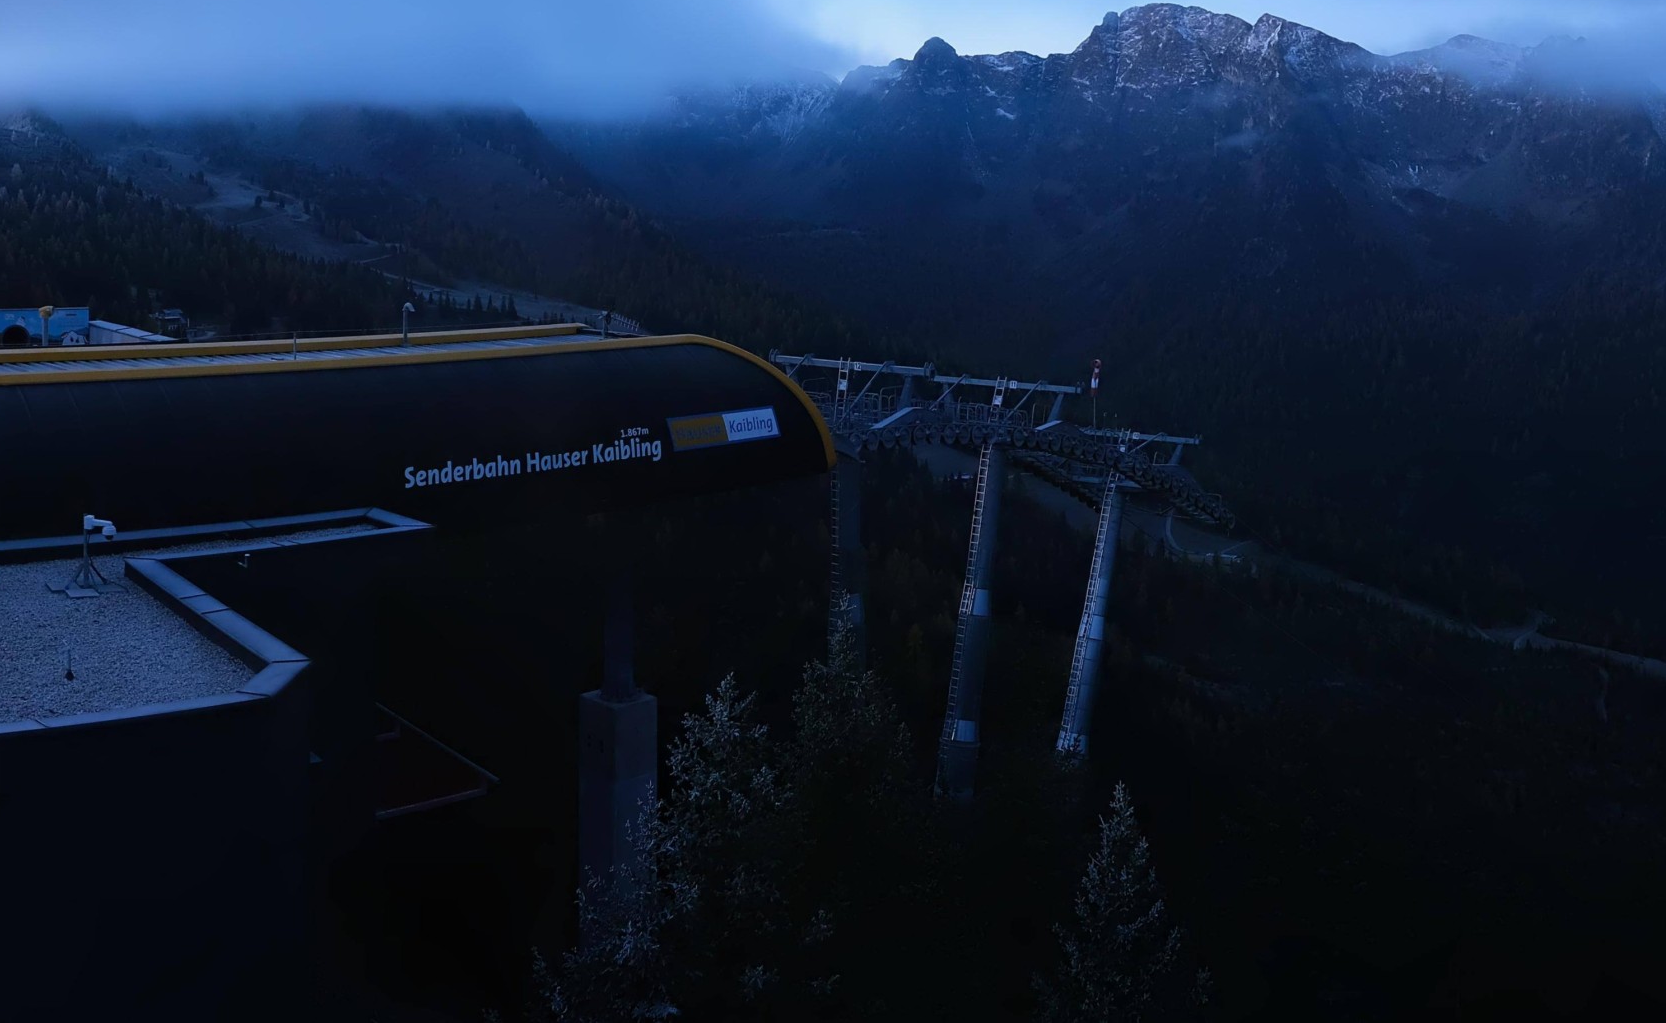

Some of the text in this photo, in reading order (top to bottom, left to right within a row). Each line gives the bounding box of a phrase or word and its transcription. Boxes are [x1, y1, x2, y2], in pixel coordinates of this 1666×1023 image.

[620, 427, 649, 438] 1.867m
[728, 416, 773, 433] Kaibling
[404, 438, 662, 488] Senderbahn Hauser Kaibling
